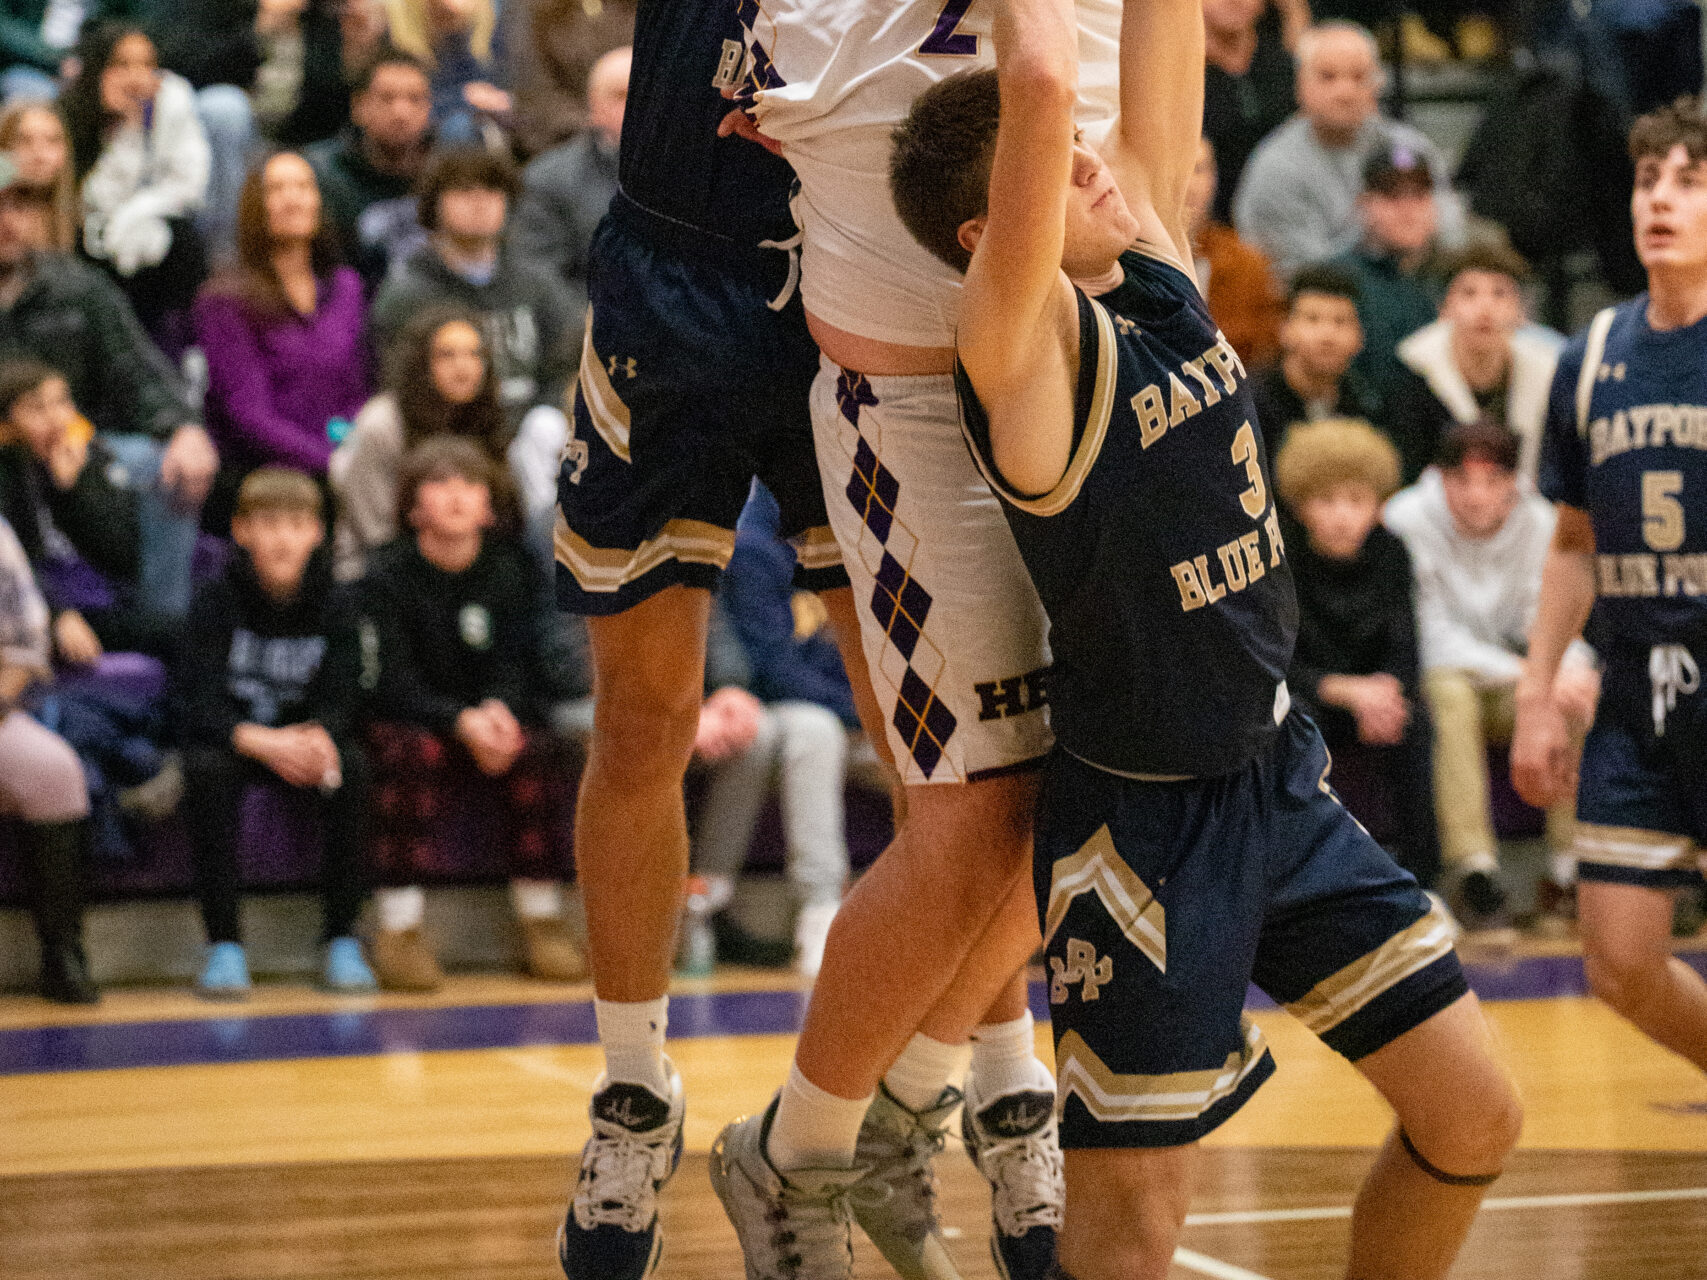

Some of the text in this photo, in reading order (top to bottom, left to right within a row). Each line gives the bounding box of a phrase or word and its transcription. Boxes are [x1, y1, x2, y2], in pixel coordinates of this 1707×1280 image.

[1230, 419, 1266, 520] 3
[1641, 470, 1685, 552] 5
[1169, 530, 1266, 613] BLUE
